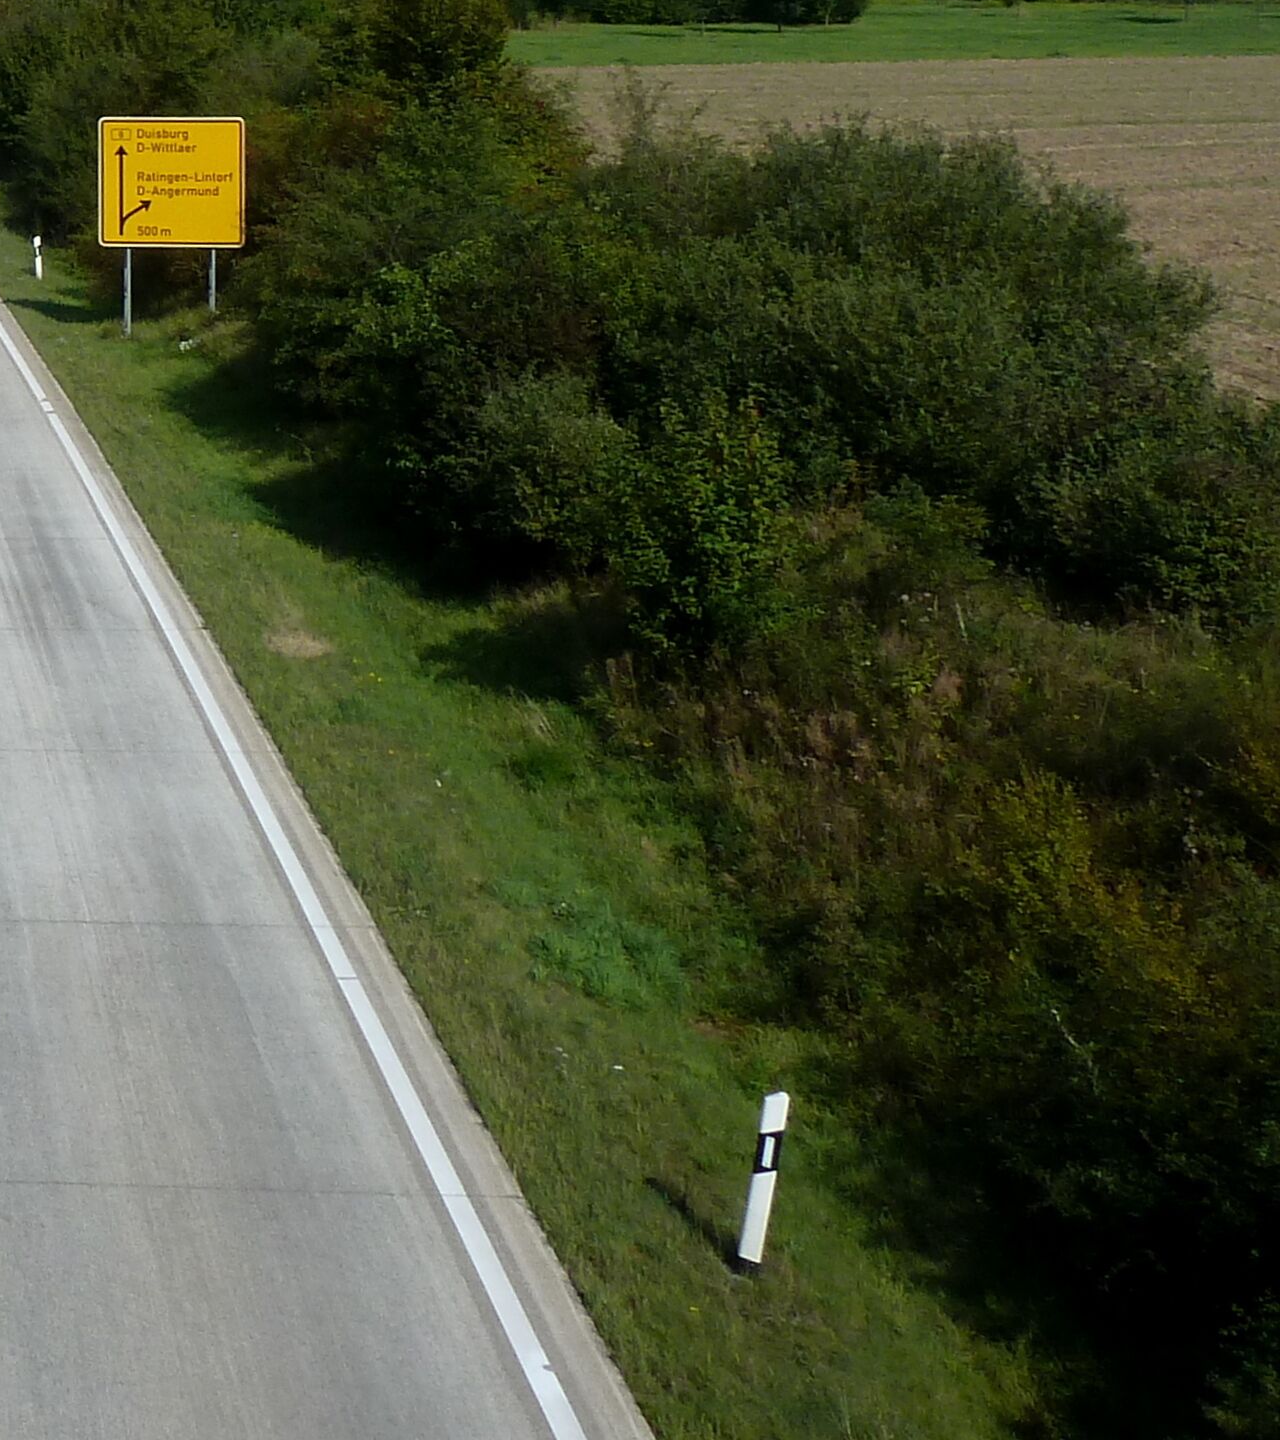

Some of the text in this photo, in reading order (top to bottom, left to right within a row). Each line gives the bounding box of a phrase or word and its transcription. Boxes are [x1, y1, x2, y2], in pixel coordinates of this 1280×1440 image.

[137, 128, 189, 141] Duisburg
[137, 143, 197, 153] D-Wittlaer
[137, 172, 233, 184] Ratingen-Lintorf
[137, 186, 220, 198] D-Angermund
[137, 226, 172, 236] 500 m
